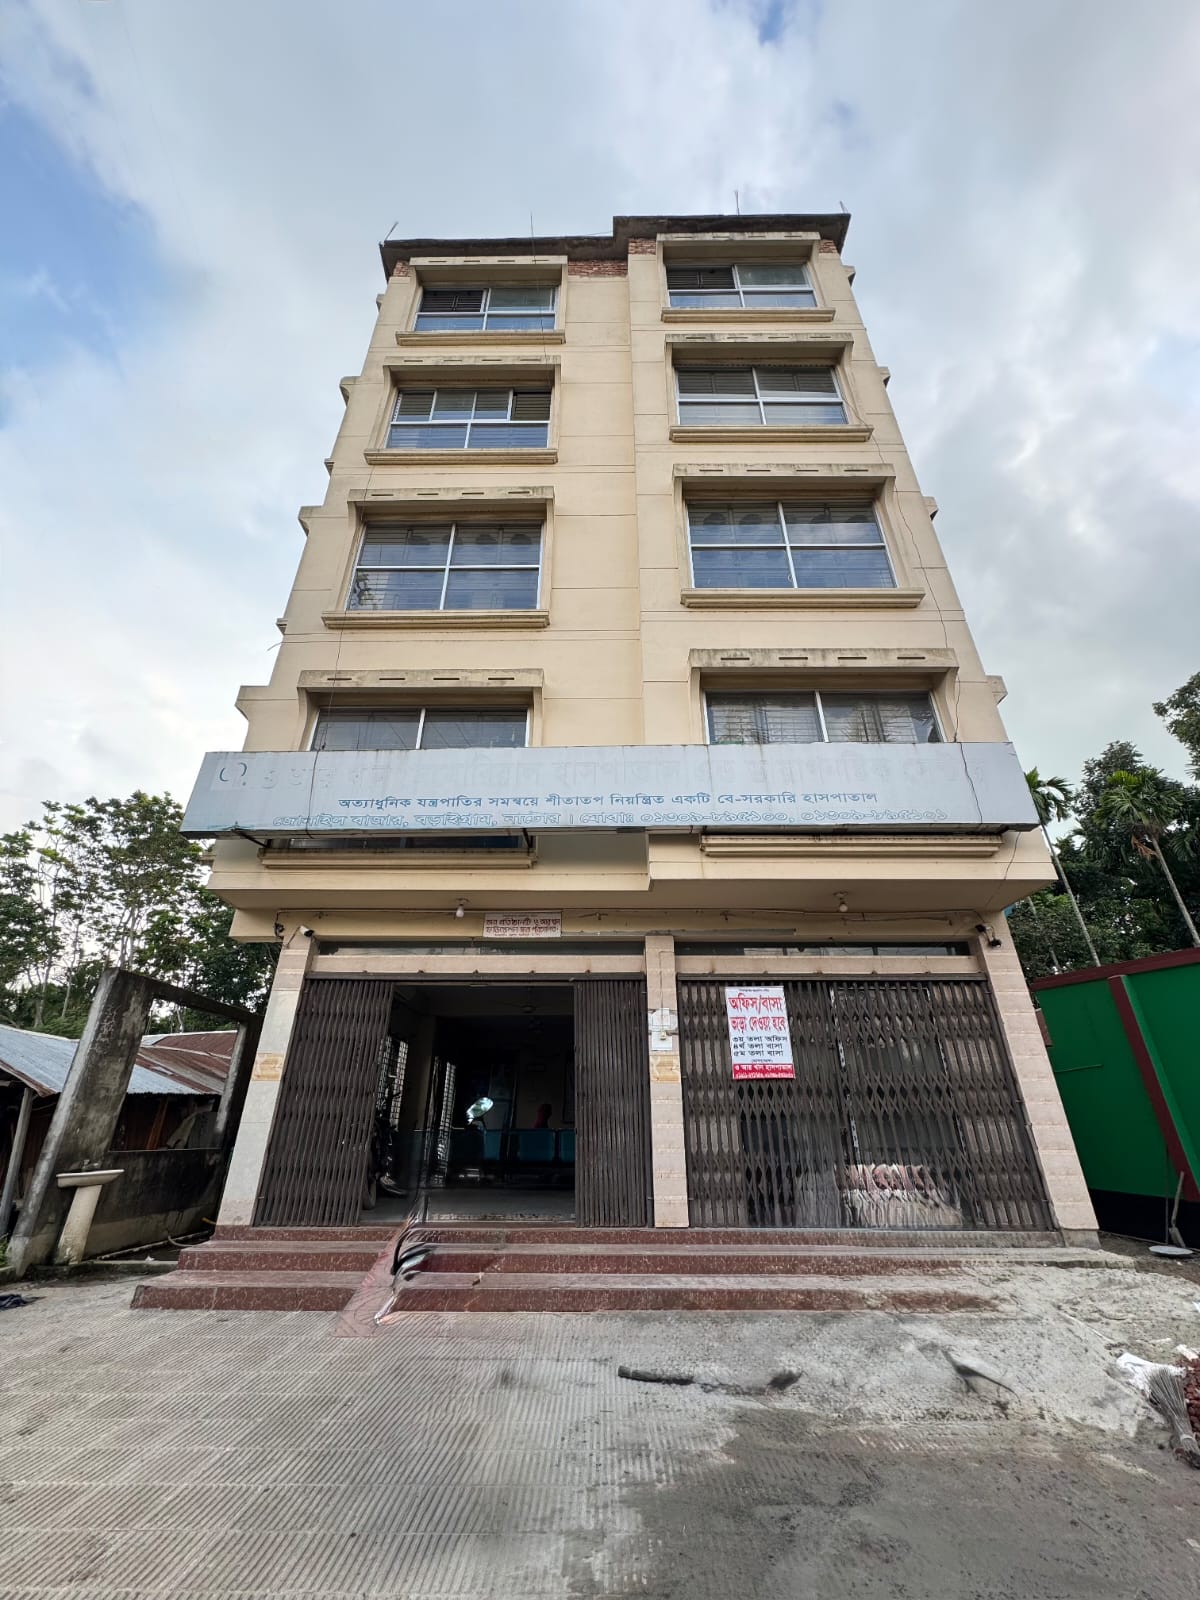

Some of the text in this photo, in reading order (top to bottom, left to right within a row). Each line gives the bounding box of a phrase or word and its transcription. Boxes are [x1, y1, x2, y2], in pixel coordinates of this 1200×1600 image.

[338, 796, 412, 810] অত্যাধুনিক
[417, 795, 482, 808] যন্ত্রপাতির
[545, 794, 604, 806] শীতাতপ
[610, 793, 665, 805] নিয়ন্ত্রিত
[671, 792, 711, 804] একটি
[717, 791, 796, 804] বে-সরকারি
[801, 791, 878, 804] হাসপাতাল
[728, 992, 784, 1014] অফিস/বাসা
[729, 1016, 787, 1034] ভাড়া দেওয়া হবে
